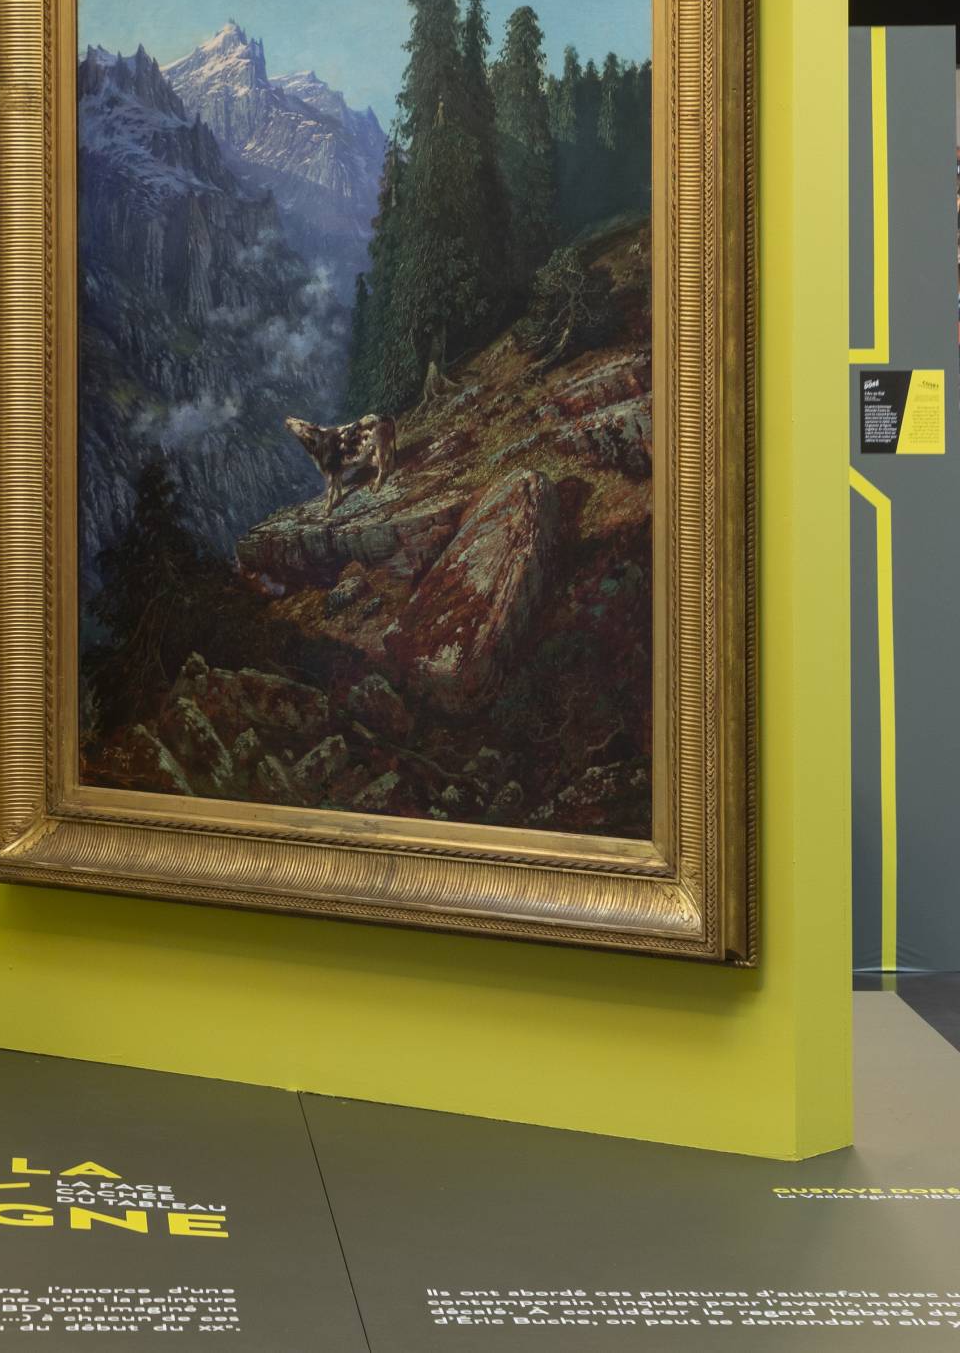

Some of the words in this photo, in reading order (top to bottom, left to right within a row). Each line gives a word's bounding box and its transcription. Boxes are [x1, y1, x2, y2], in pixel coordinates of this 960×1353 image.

[10, 1157, 123, 1179] LA
[56, 1179, 91, 1188] LA
[99, 1182, 172, 1193] FACE
[55, 1187, 176, 1202] CACHÉE
[56, 1195, 96, 1205] DU
[103, 1198, 227, 1212] TABLEAU
[48, 1286, 150, 1294] l'amorce
[169, 1286, 234, 1294] d'une
[37, 1295, 105, 1305] qu'est
[113, 1295, 130, 1303] la
[140, 1295, 236, 1305] peinture
[2, 1304, 41, 1312] BD
[53, 1304, 92, 1312] ont
[104, 1304, 197, 1314] imaginé
[528, 1306, 549, 1315] À
[64, 1313, 151, 1322] chacun
[162, 1313, 191, 1322] de
[20, 1323, 49, 1331] du
[65, 1323, 138, 1331] début
[153, 1323, 183, 1331] du
